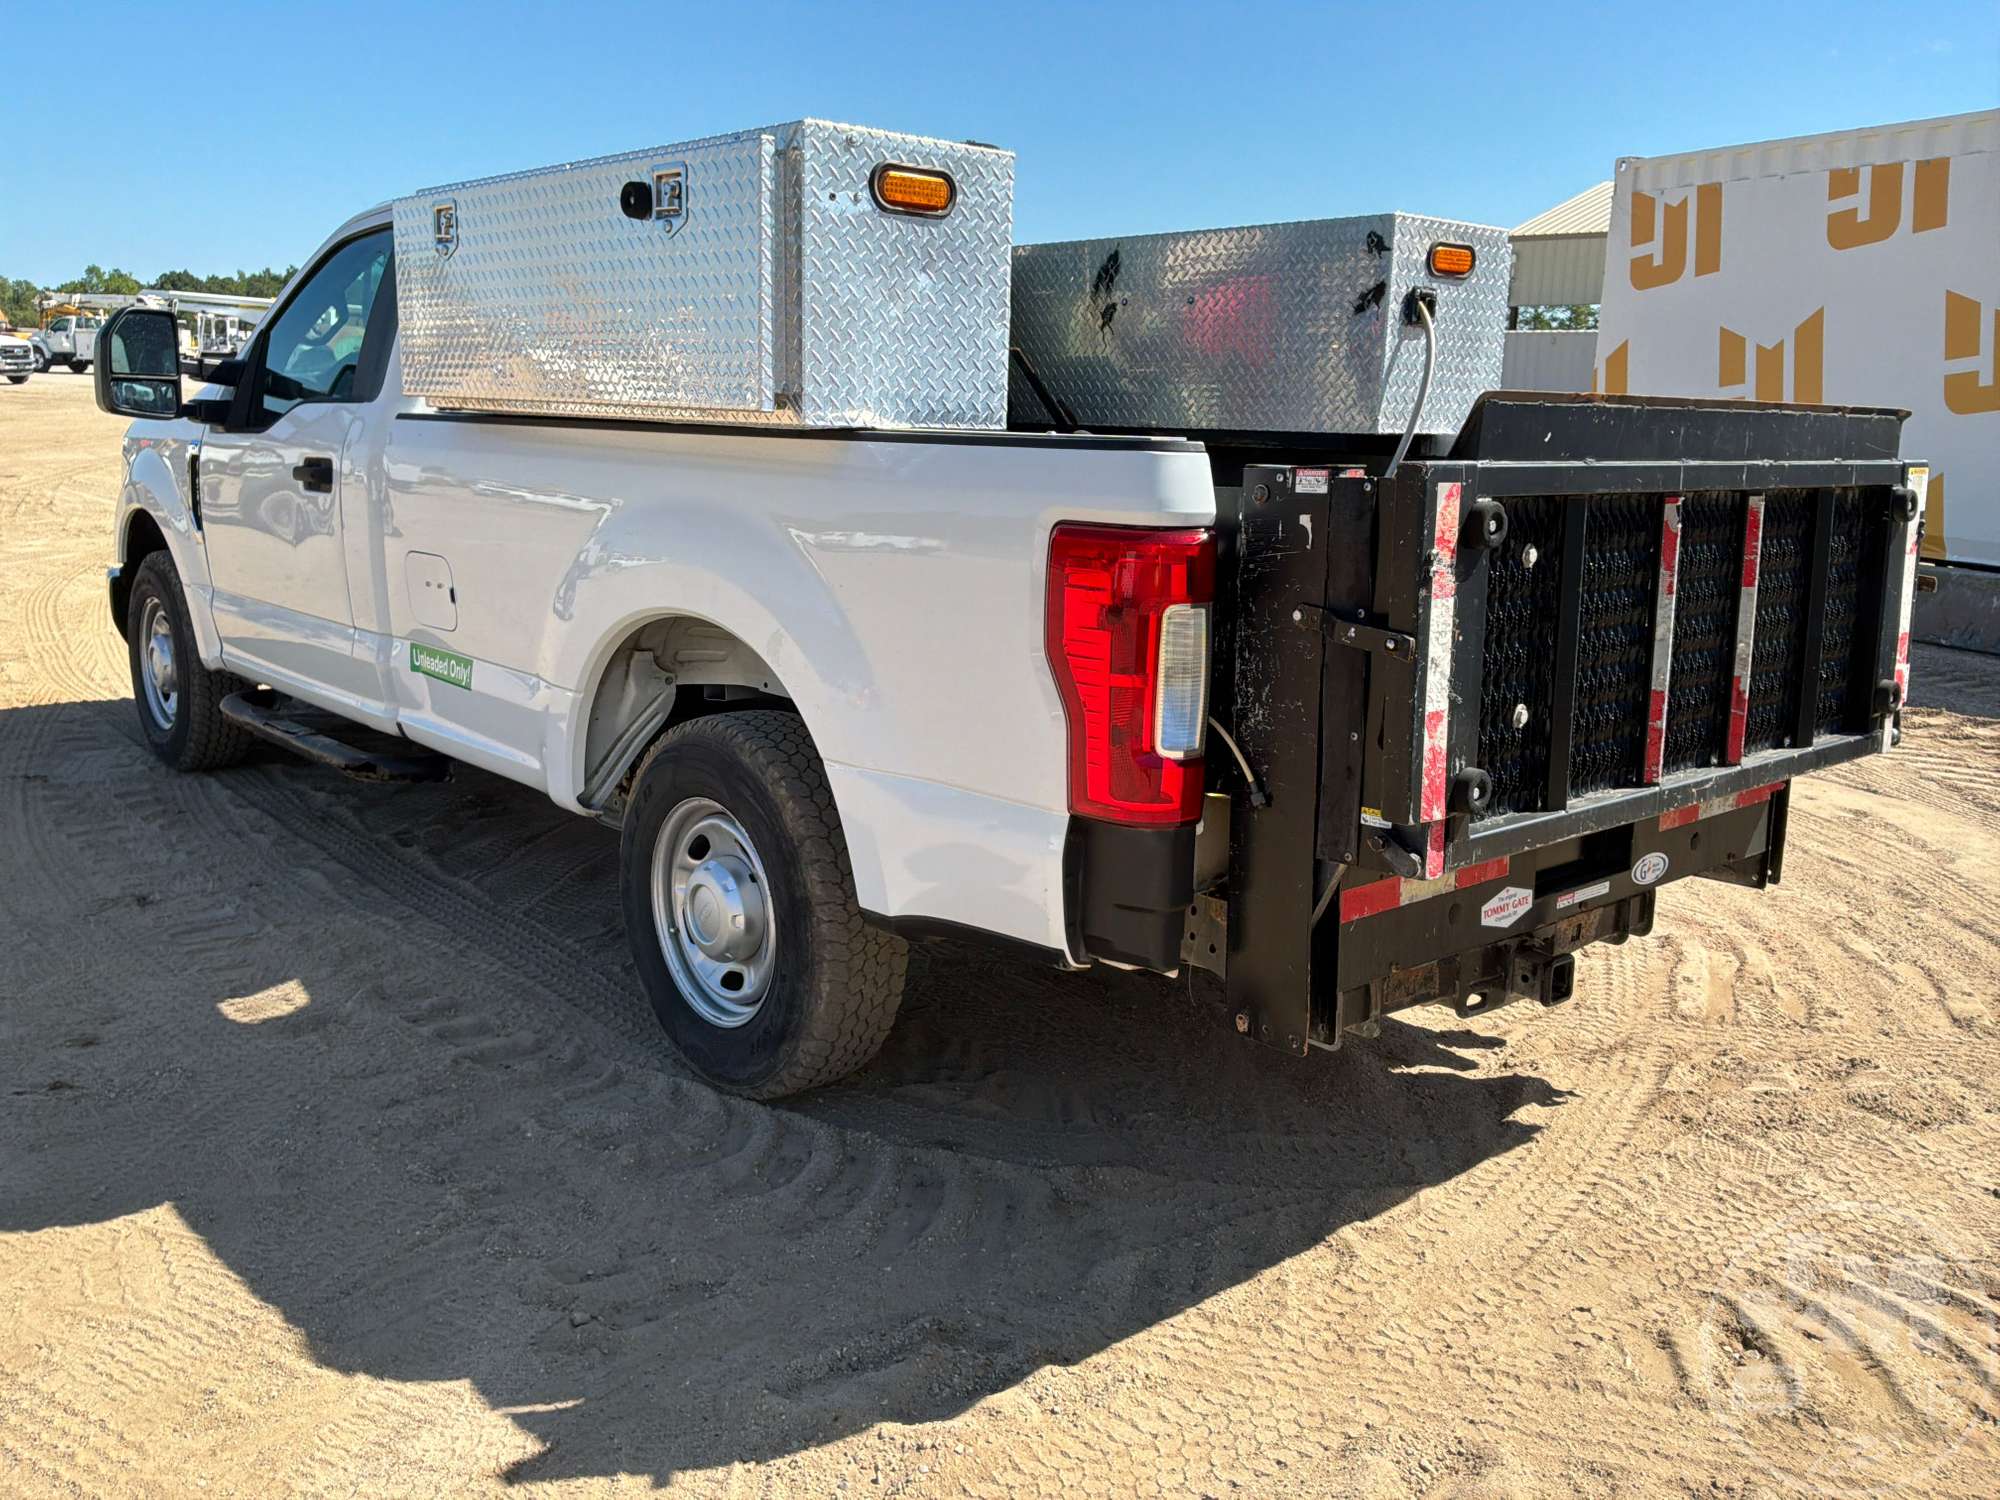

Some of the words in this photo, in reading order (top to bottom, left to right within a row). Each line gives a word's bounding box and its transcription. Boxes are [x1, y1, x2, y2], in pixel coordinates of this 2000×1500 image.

[412, 648, 448, 676] Unleaded
[1483, 902, 1510, 920] TOMMY
[1512, 895, 1529, 909] GATE
